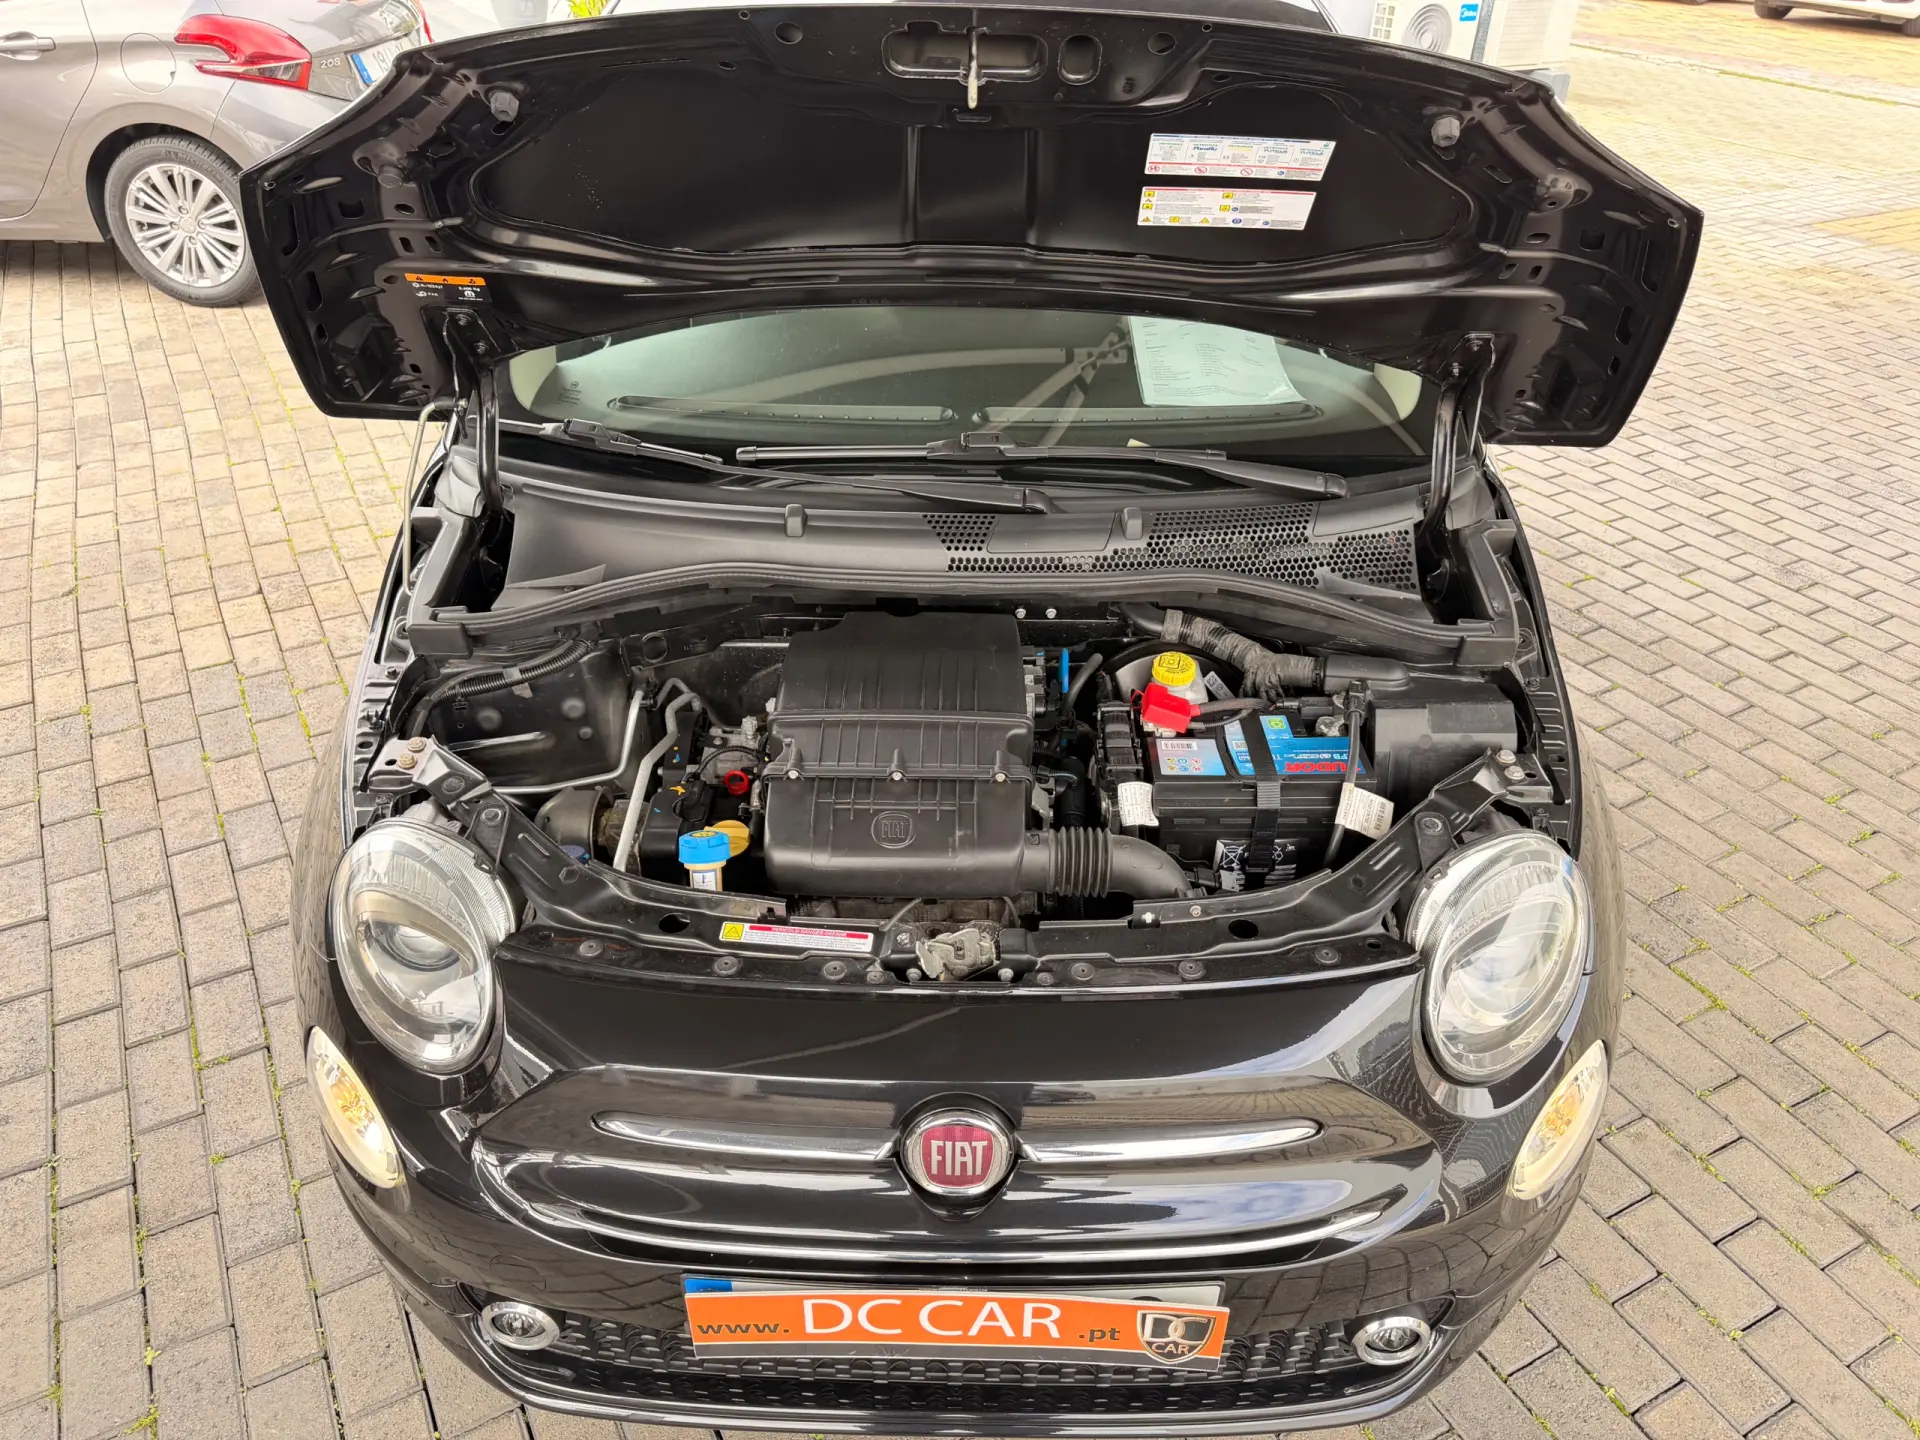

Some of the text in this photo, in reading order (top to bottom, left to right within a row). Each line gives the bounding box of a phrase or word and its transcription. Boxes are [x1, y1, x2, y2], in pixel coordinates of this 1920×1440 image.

[320, 57, 341, 69] 208
[1285, 761, 1362, 773] UDOR
[881, 820, 909, 838] FIAT
[930, 1139, 988, 1177] FIAT
[696, 1298, 1121, 1343] www. DC CAR .pt
[1142, 1312, 1209, 1346] DC
[1151, 1342, 1190, 1355] CAR
